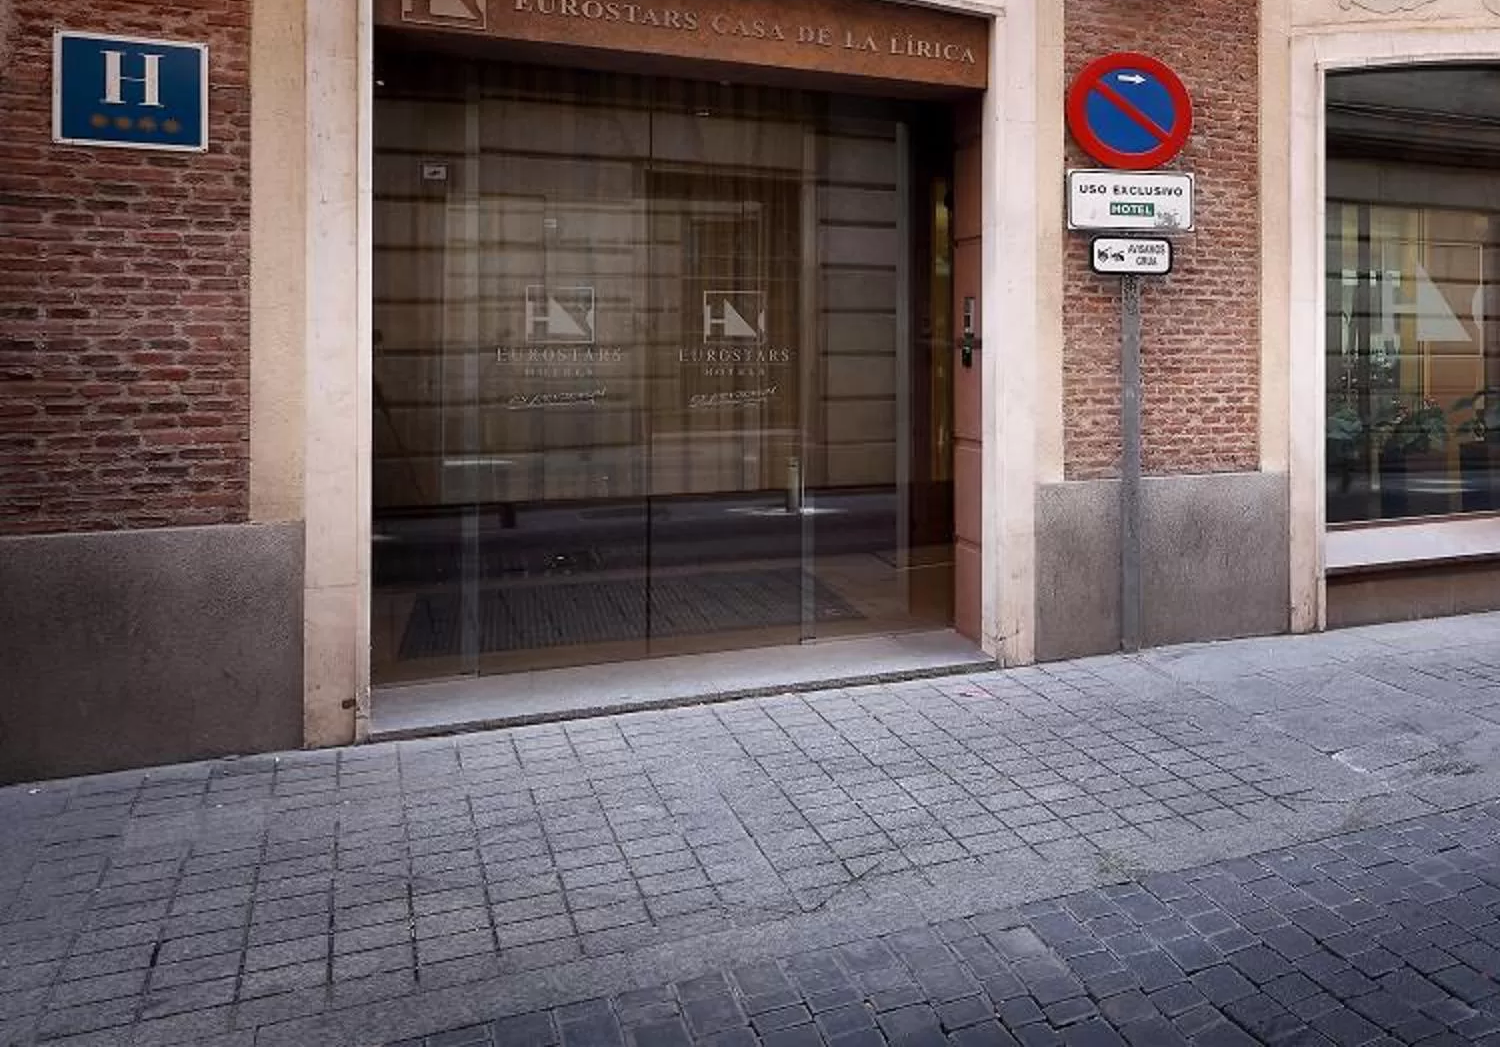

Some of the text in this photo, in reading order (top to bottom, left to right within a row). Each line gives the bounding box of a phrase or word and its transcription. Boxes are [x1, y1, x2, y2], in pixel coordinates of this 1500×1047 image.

[711, 13, 785, 42] CASA
[797, 25, 832, 47] DE
[844, 31, 879, 52] LA
[890, 33, 976, 65] LÍRICA
[100, 49, 165, 108] H
[1079, 184, 1183, 196] USO EXCLUSIVO
[1111, 204, 1153, 214] HOTEL
[679, 348, 790, 363] EUROSTARS
